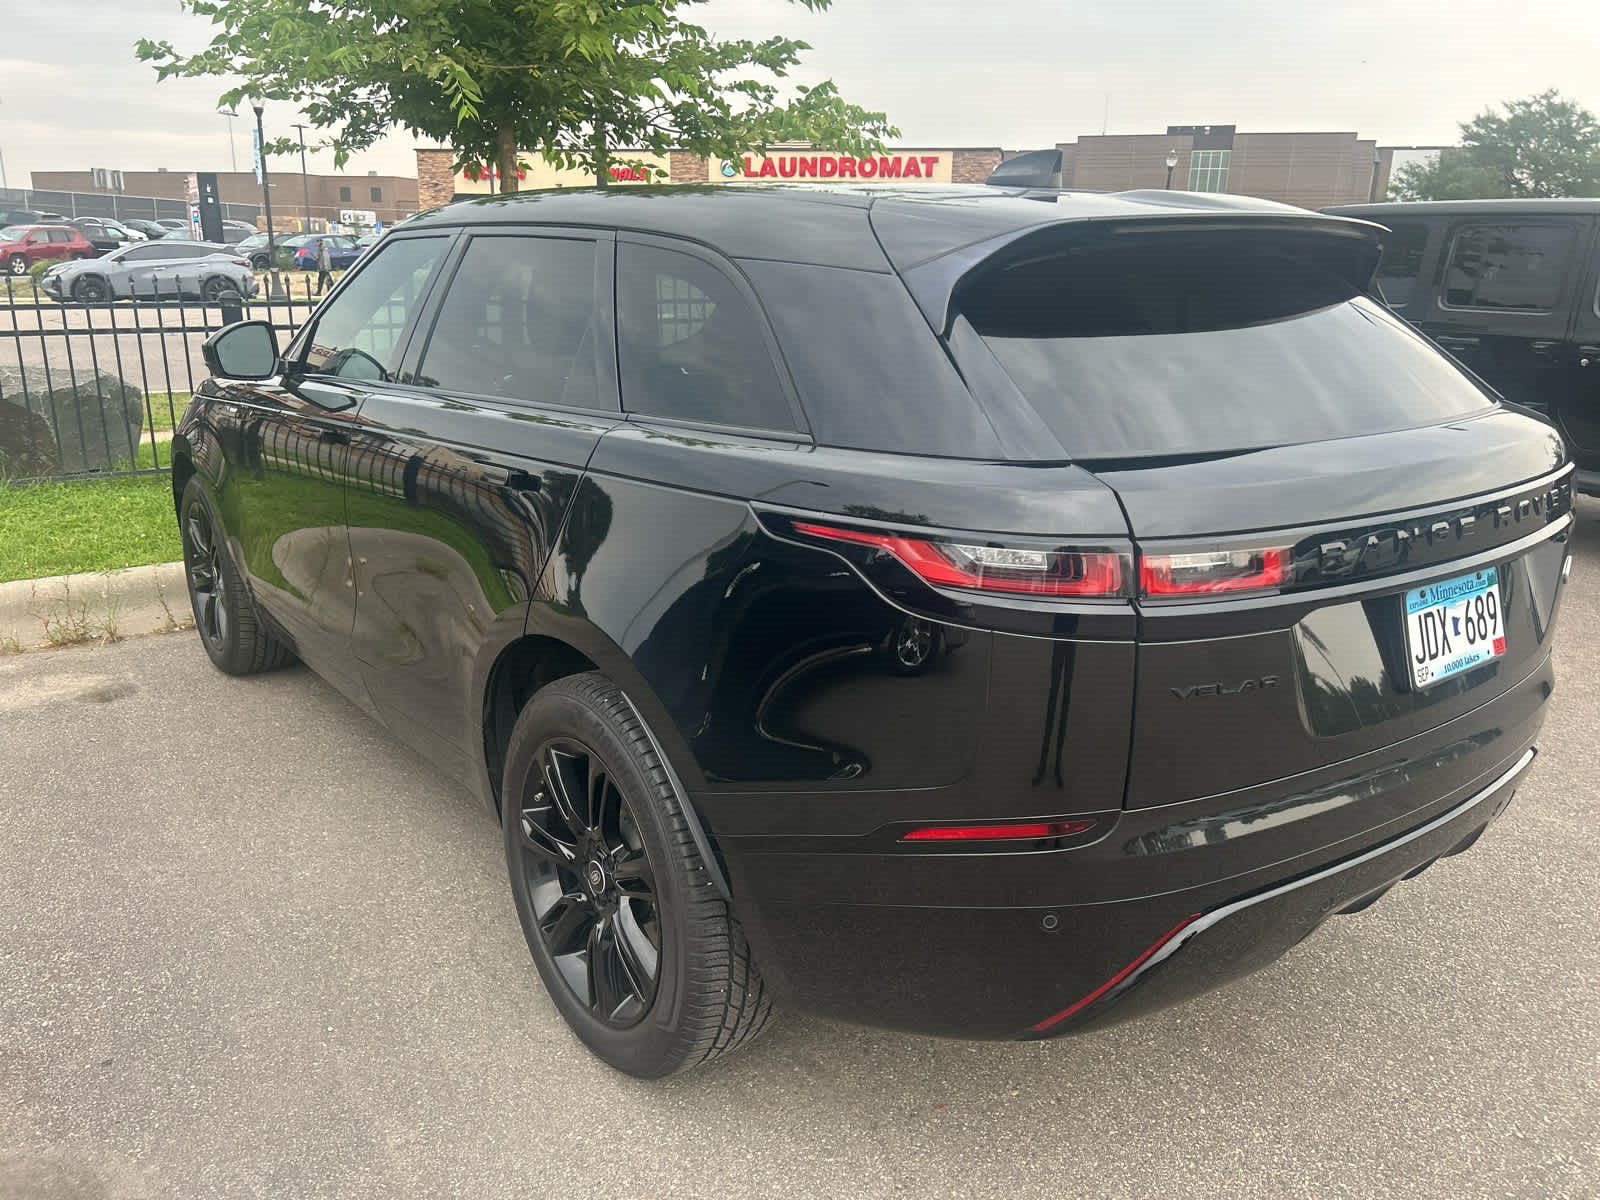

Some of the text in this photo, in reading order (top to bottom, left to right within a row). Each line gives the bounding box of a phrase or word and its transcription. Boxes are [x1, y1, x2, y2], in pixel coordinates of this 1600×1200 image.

[743, 157, 939, 178] LAUNDROMAT
[1320, 515, 1476, 577] RANGE
[1415, 591, 1498, 665] JDX 689
[1168, 674, 1280, 702] VELAR
[1417, 666, 1430, 684] SEP
